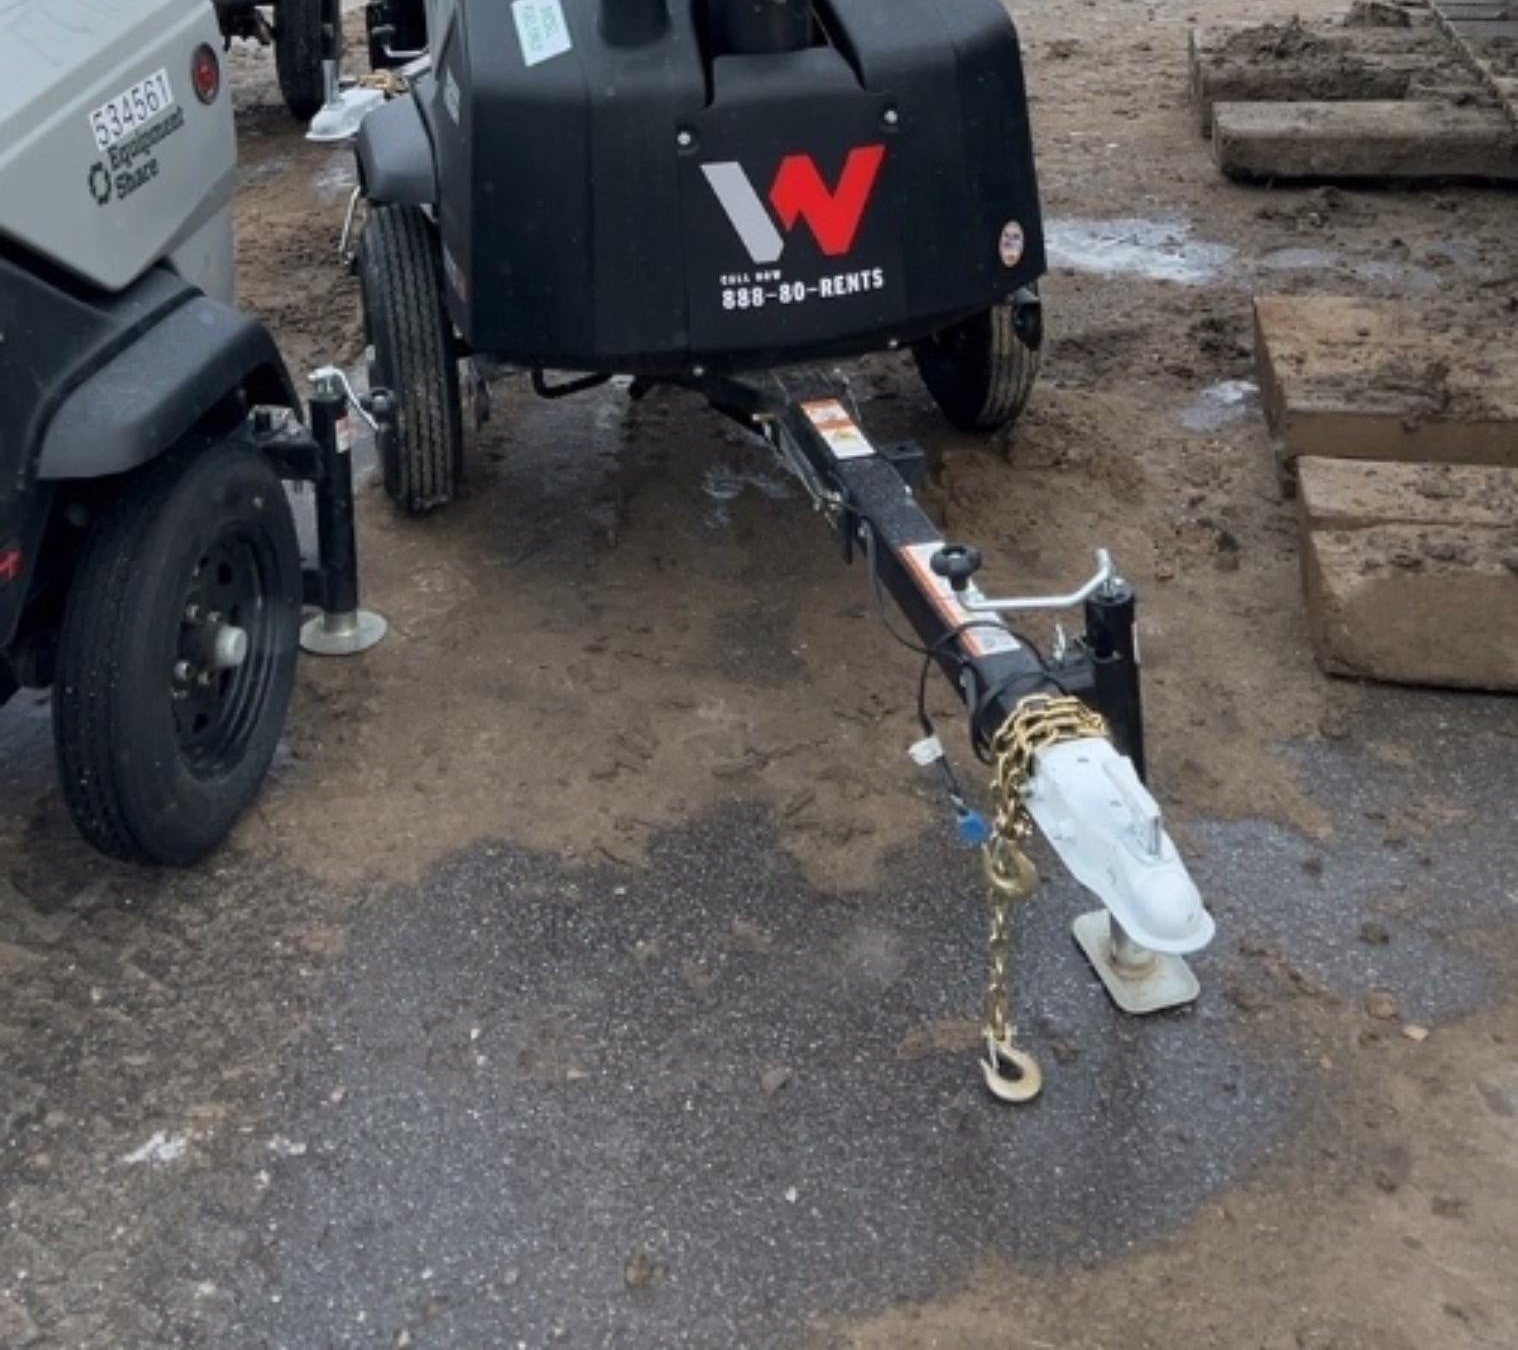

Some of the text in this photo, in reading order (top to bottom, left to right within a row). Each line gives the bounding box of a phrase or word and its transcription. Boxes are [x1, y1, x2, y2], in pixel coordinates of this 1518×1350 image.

[93, 73, 169, 146] 534561
[107, 105, 185, 172] Equipment
[114, 157, 159, 200] Share
[721, 266, 884, 310] 888-80-RENTS
